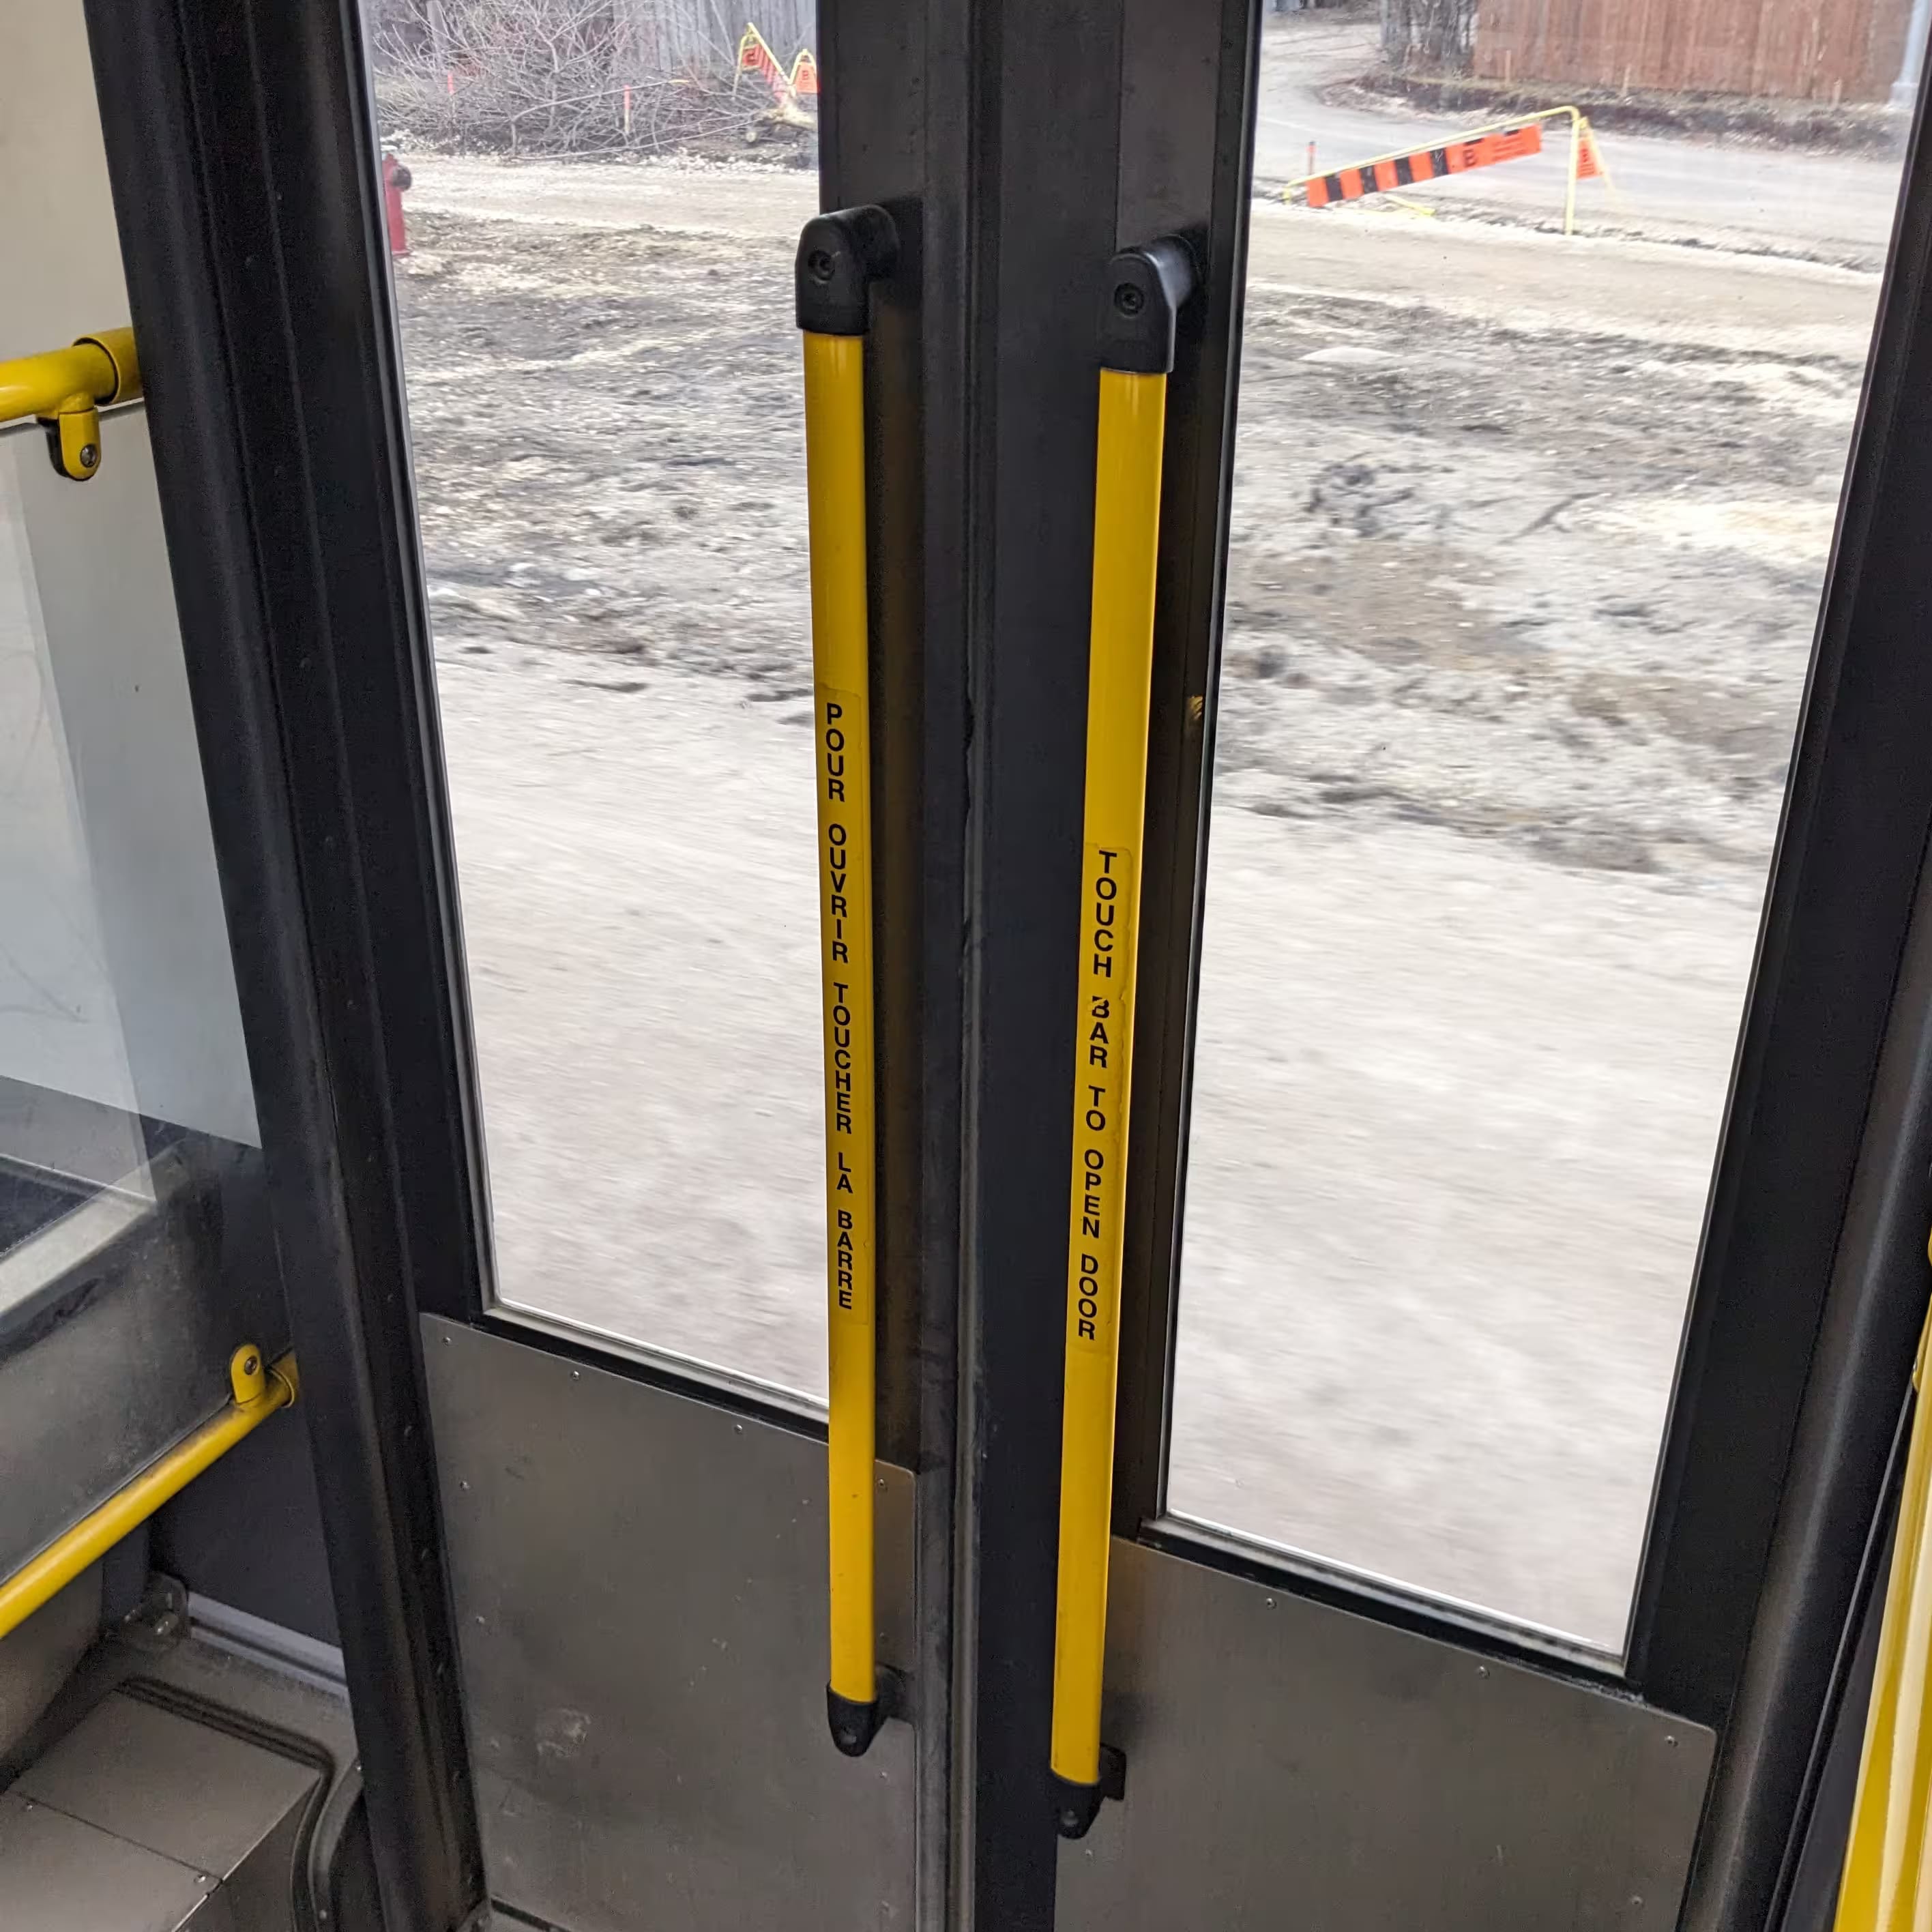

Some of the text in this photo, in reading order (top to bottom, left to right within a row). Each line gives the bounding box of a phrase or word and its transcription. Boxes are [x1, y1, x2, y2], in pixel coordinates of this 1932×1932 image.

[1093, 850, 1117, 978] TOUCH
[825, 702, 853, 1310] POUR OUVRIR TOUCHER LA BARRE
[1085, 1085, 1106, 1131] TO
[1082, 1149, 1104, 1239] OPEN
[1078, 1253, 1099, 1341] DOOR
